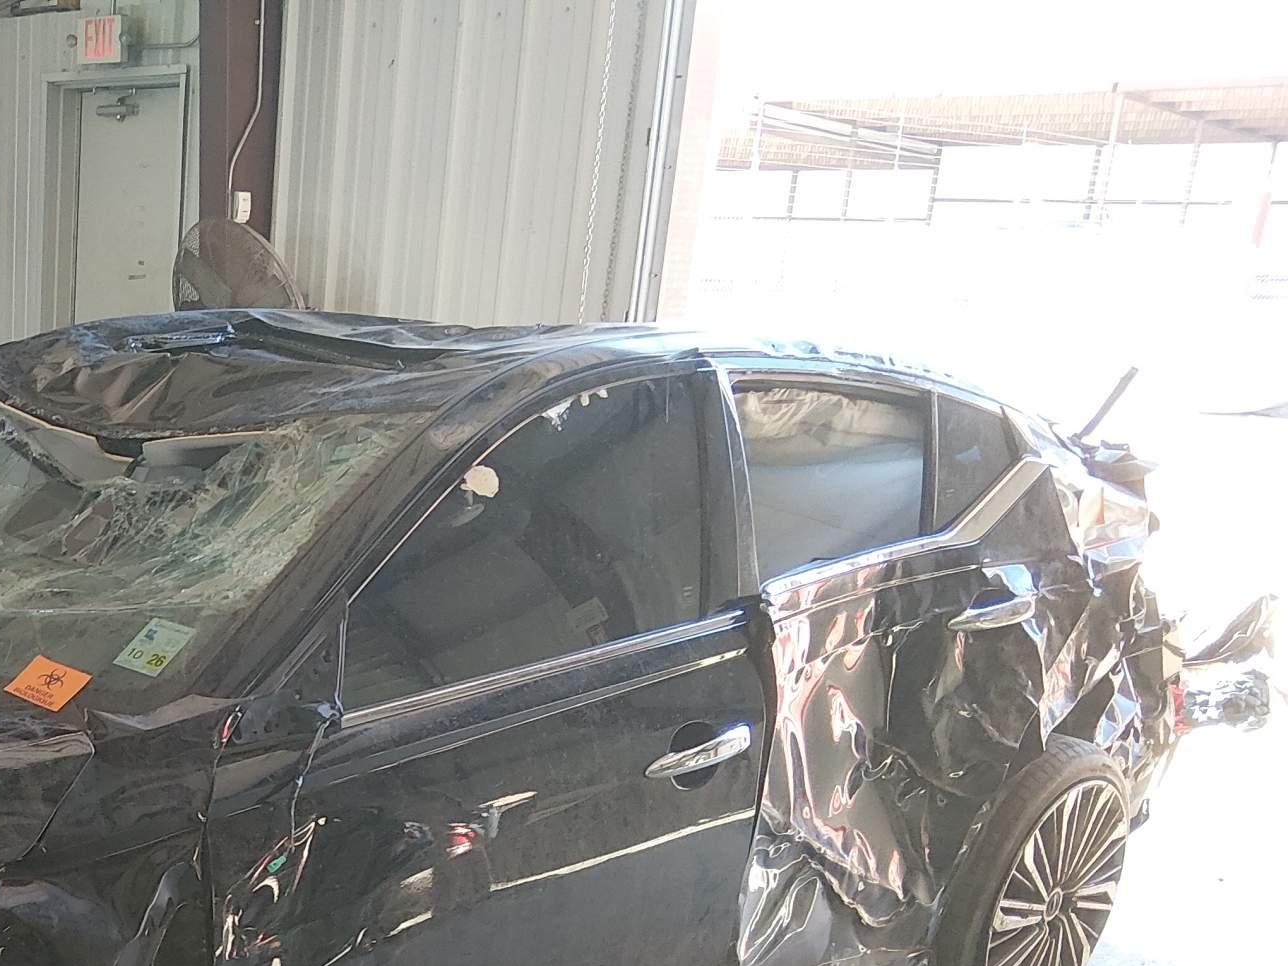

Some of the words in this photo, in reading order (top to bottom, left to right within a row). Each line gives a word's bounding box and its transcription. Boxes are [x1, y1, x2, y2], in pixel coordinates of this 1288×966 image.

[85, 17, 115, 57] EXIT
[127, 648, 144, 659] 10
[146, 653, 166, 667] 26
